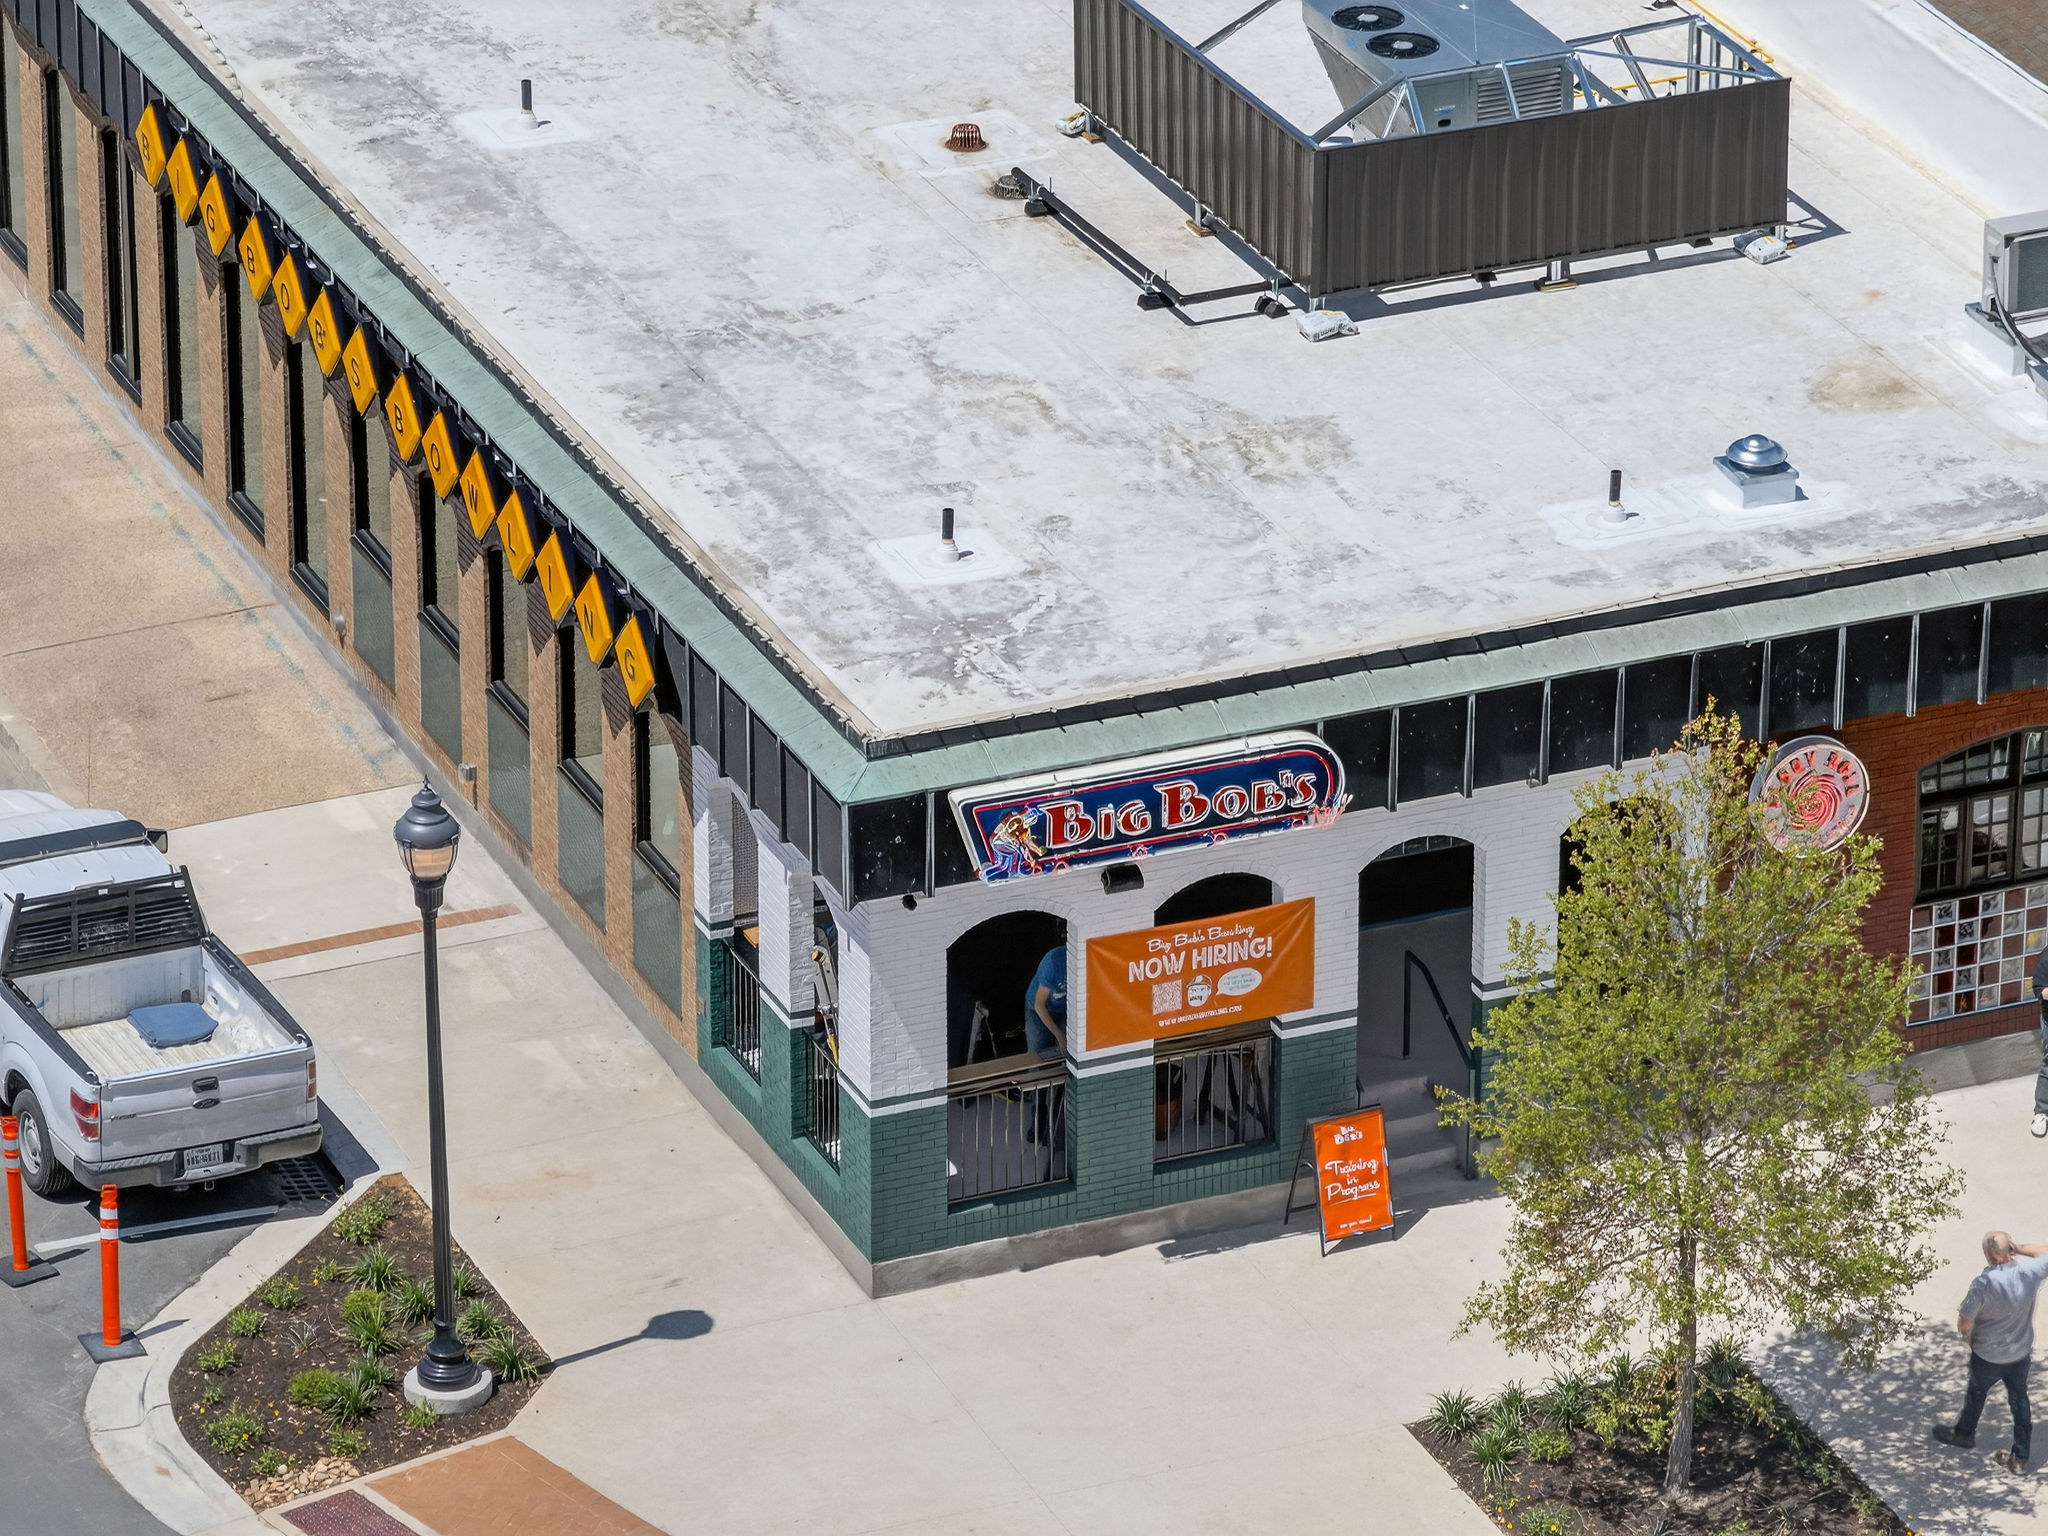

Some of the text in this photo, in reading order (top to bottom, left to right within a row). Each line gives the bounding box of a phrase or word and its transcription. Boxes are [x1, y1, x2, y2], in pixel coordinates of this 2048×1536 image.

[394, 403, 635, 682] BOWLING
[1041, 770, 1317, 849] BIG BOB'S
[1146, 938, 1171, 953] Big
[1173, 929, 1206, 947] Bob's
[1128, 950, 1186, 983] NOW
[1192, 936, 1273, 970] HIRING!
[1324, 1157, 1379, 1176] Training
[1324, 1180, 1381, 1201] Progress
[1345, 1173, 1359, 1186] in
